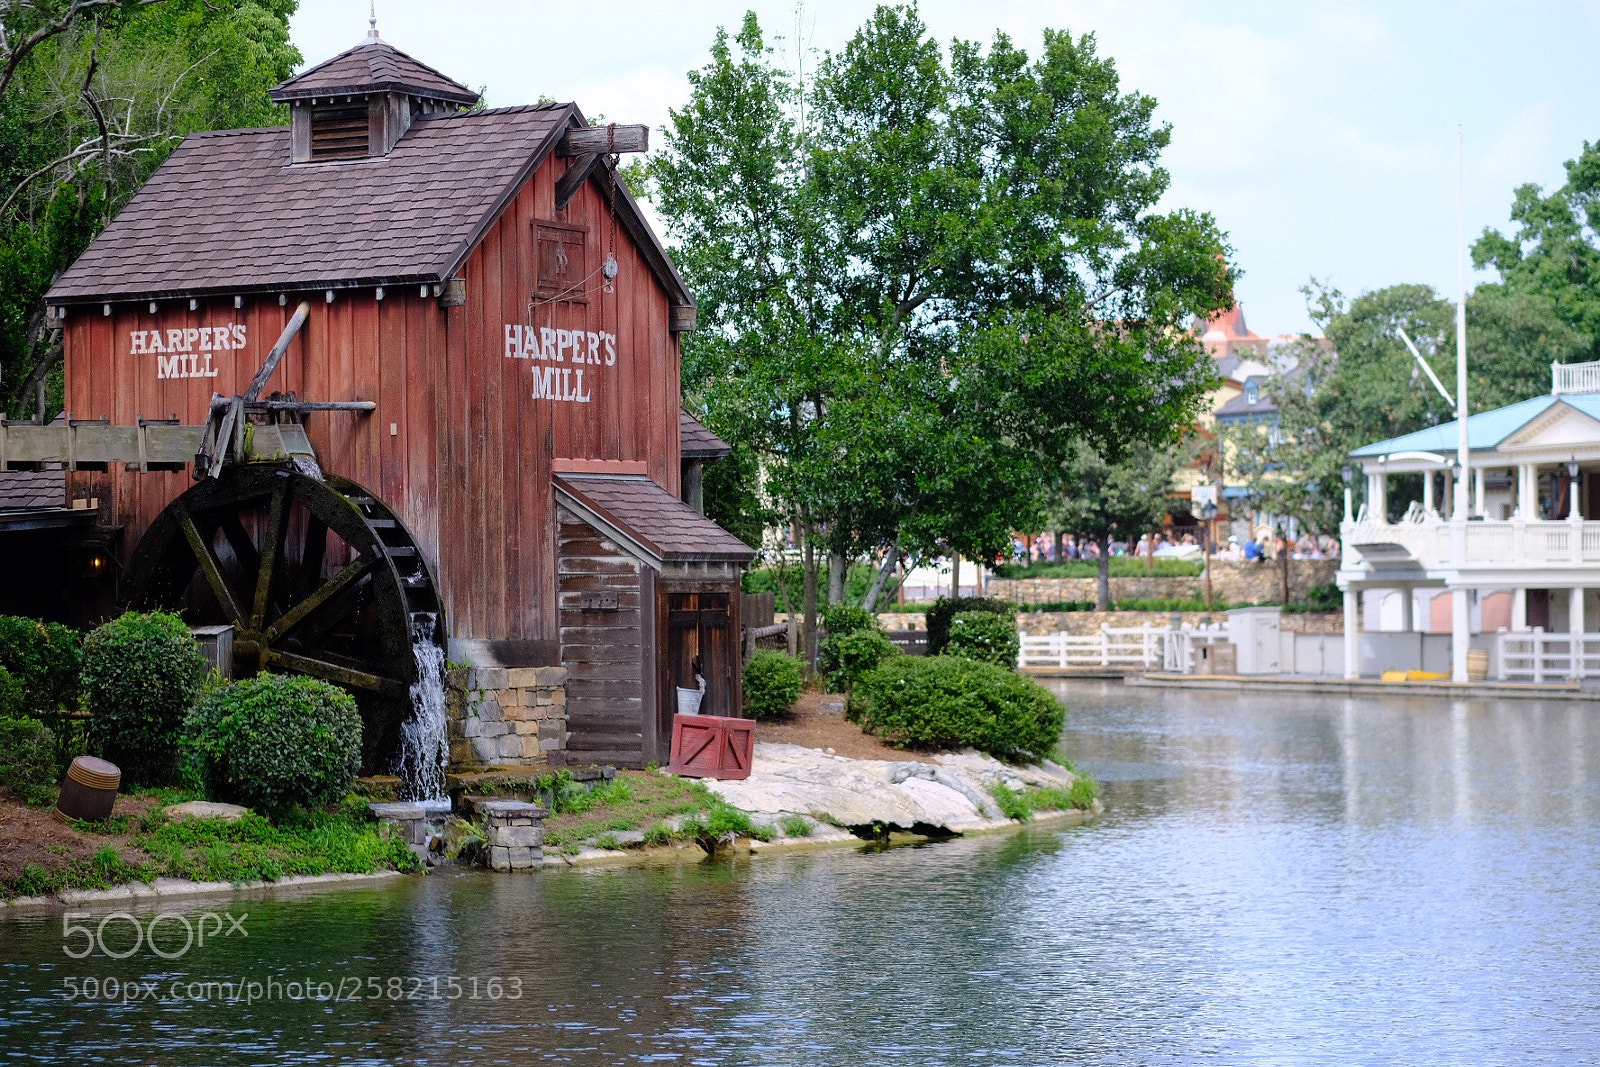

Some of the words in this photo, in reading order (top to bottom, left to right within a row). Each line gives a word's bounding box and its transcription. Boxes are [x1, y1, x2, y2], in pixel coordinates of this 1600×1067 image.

[130, 322, 247, 355] HARPER'S
[504, 323, 617, 367] HARPER'S
[157, 353, 220, 379] MILL
[531, 365, 591, 403] MILL
